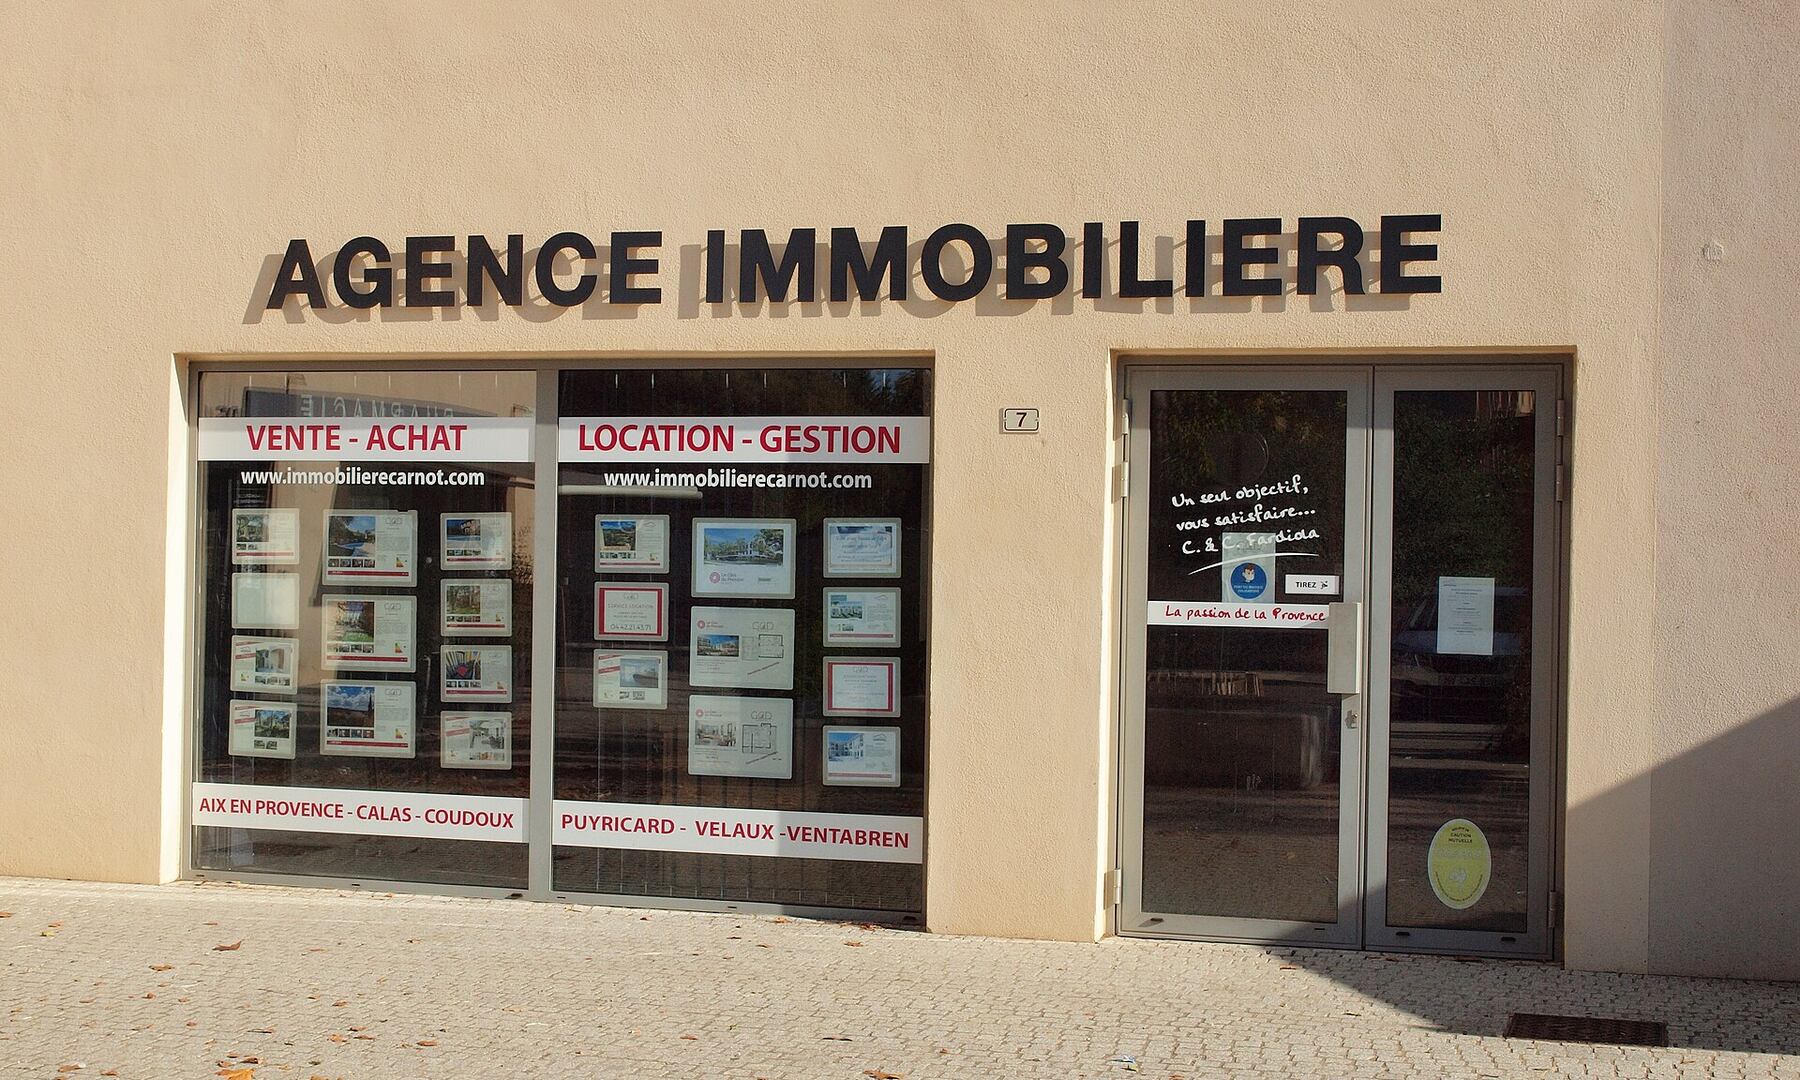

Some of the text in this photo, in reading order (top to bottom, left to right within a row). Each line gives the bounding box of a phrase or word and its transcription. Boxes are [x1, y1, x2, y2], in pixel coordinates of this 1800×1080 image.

[266, 214, 1441, 309] AGENCE IMMOBILIERE
[1016, 412, 1027, 428] 7
[246, 424, 341, 451] VENTE
[366, 424, 468, 452] ACHAT
[578, 423, 735, 453] LOCATION
[759, 424, 901, 455] GESTION
[240, 466, 486, 487] www.immobilierecarnot.com
[603, 468, 873, 489] www.immobilierecarnot.com
[1171, 474, 1309, 508] Un seul objectif,
[1176, 503, 1316, 531] vous satisfaire...
[1182, 540, 1201, 555] C.
[1205, 537, 1219, 552] &
[1222, 536, 1240, 549] C.
[1295, 581, 1317, 589] TIREZ
[1165, 605, 1326, 622] La passion de la Provence
[199, 798, 227, 813] AIX
[230, 799, 252, 815] EN
[255, 800, 344, 819] PROVENCE
[356, 804, 412, 822] CALAS
[424, 808, 514, 829] COUDOUX
[561, 814, 676, 835] PUYRICARD
[695, 820, 775, 841] VELAUX
